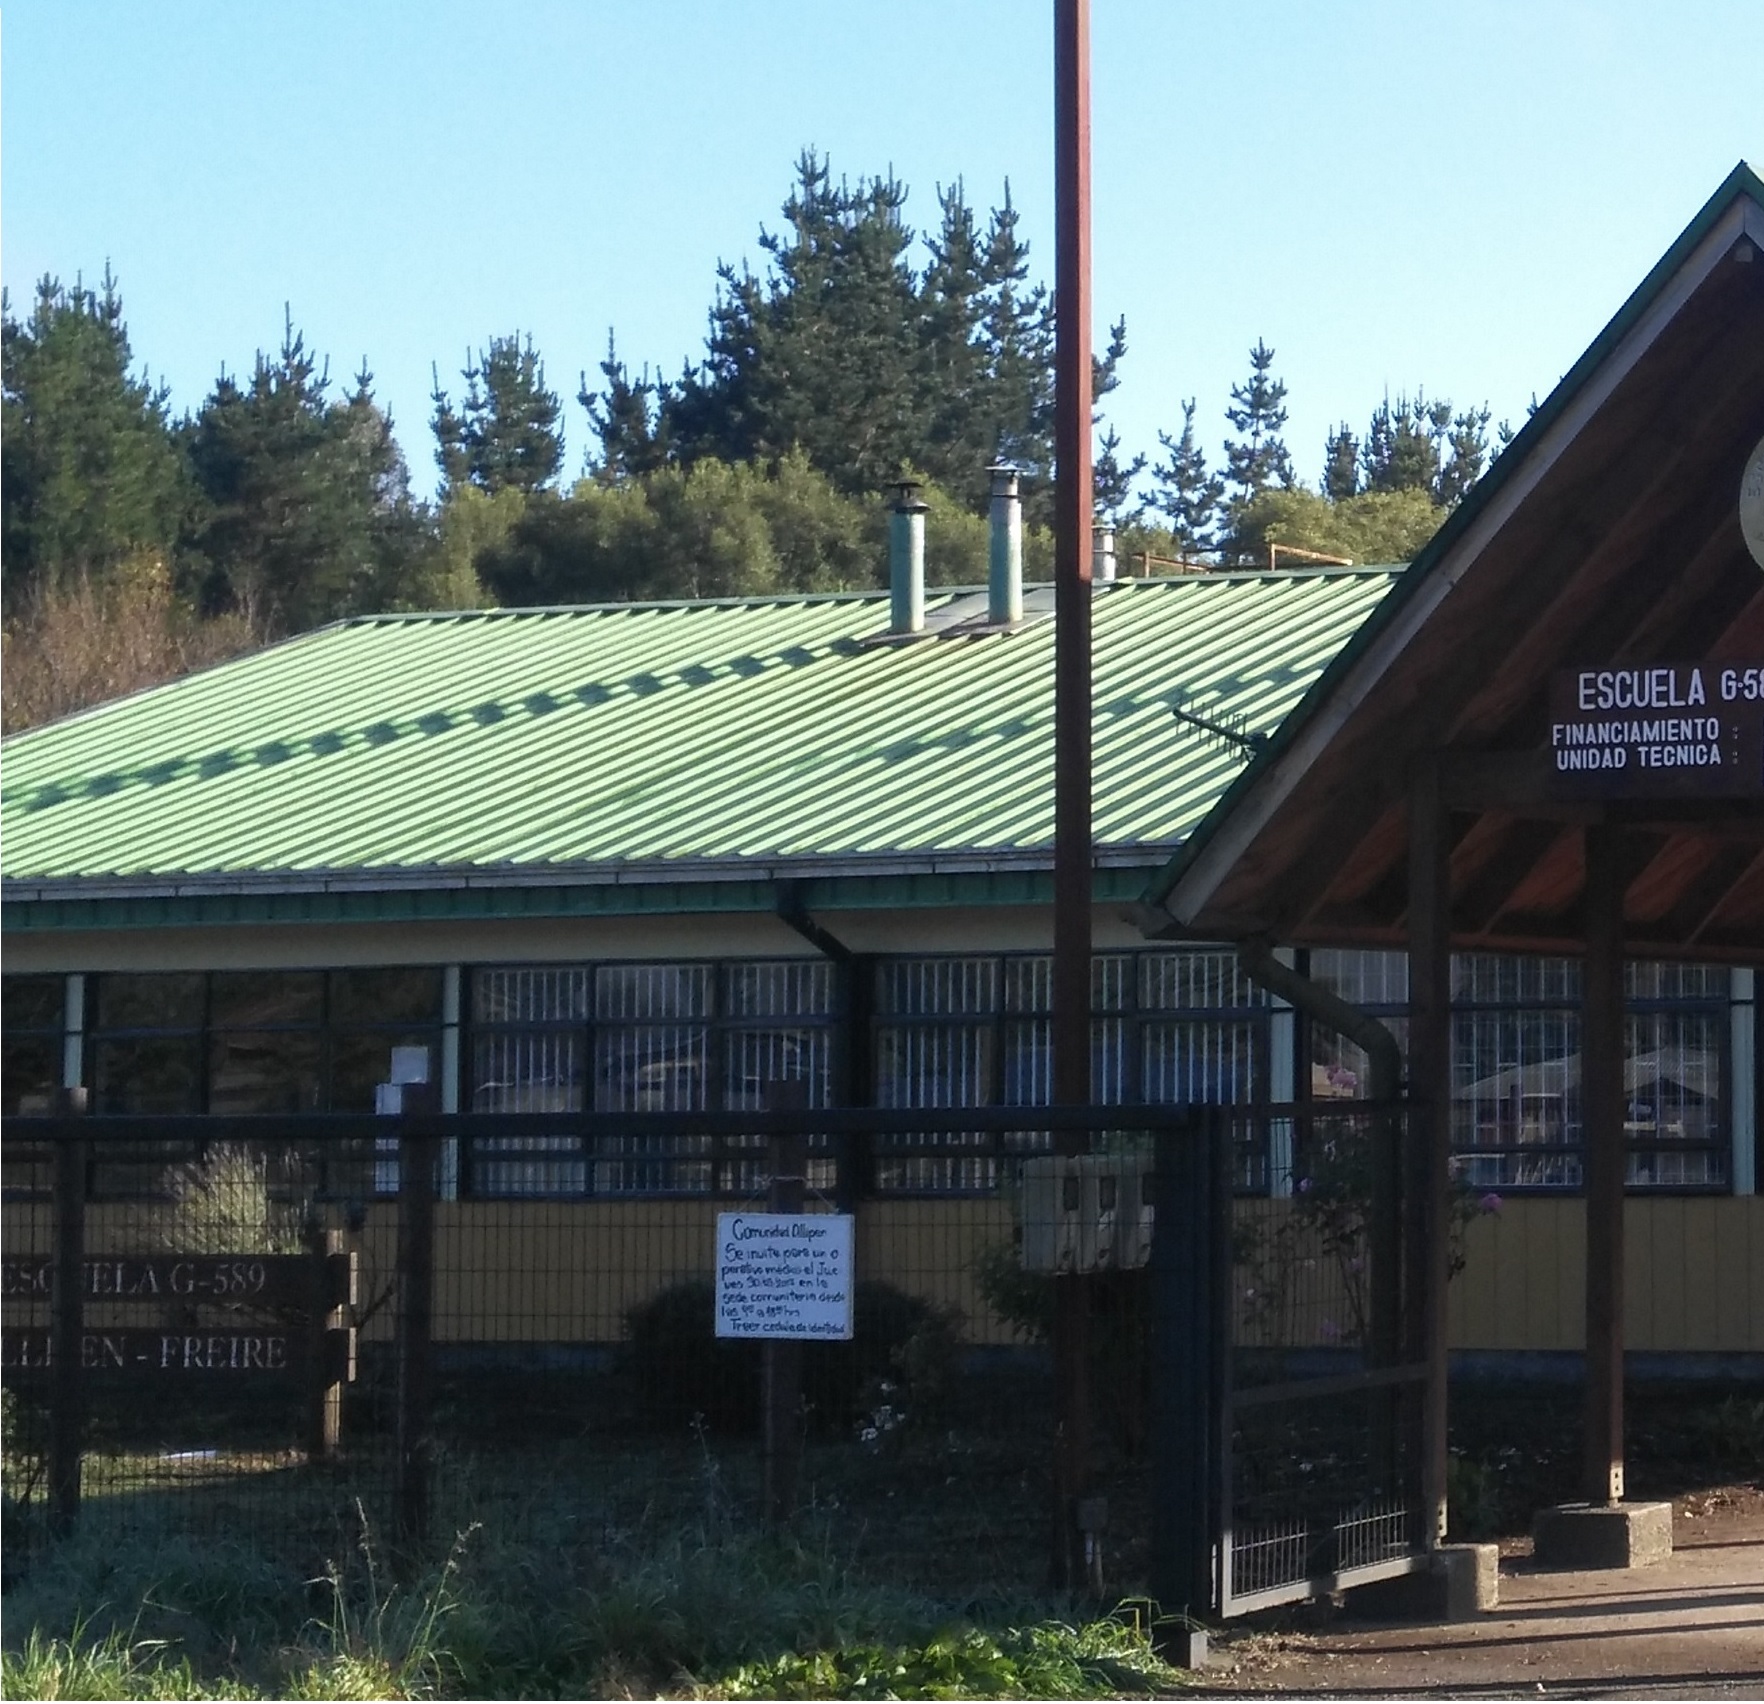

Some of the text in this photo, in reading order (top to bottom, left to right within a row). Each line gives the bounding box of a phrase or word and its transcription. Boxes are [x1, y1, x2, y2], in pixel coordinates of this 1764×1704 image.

[1577, 667, 1706, 710] ESCUELA
[1552, 717, 1721, 746] FINANCIAMIENTO
[1556, 748, 1627, 771] UNIDAD
[1637, 743, 1722, 767] TECNICA
[725, 1243, 743, 1262] Se
[1, 1262, 266, 1295] ESCELA G-589
[799, 1279, 813, 1288] en
[160, 1336, 288, 1369] FREIRE
